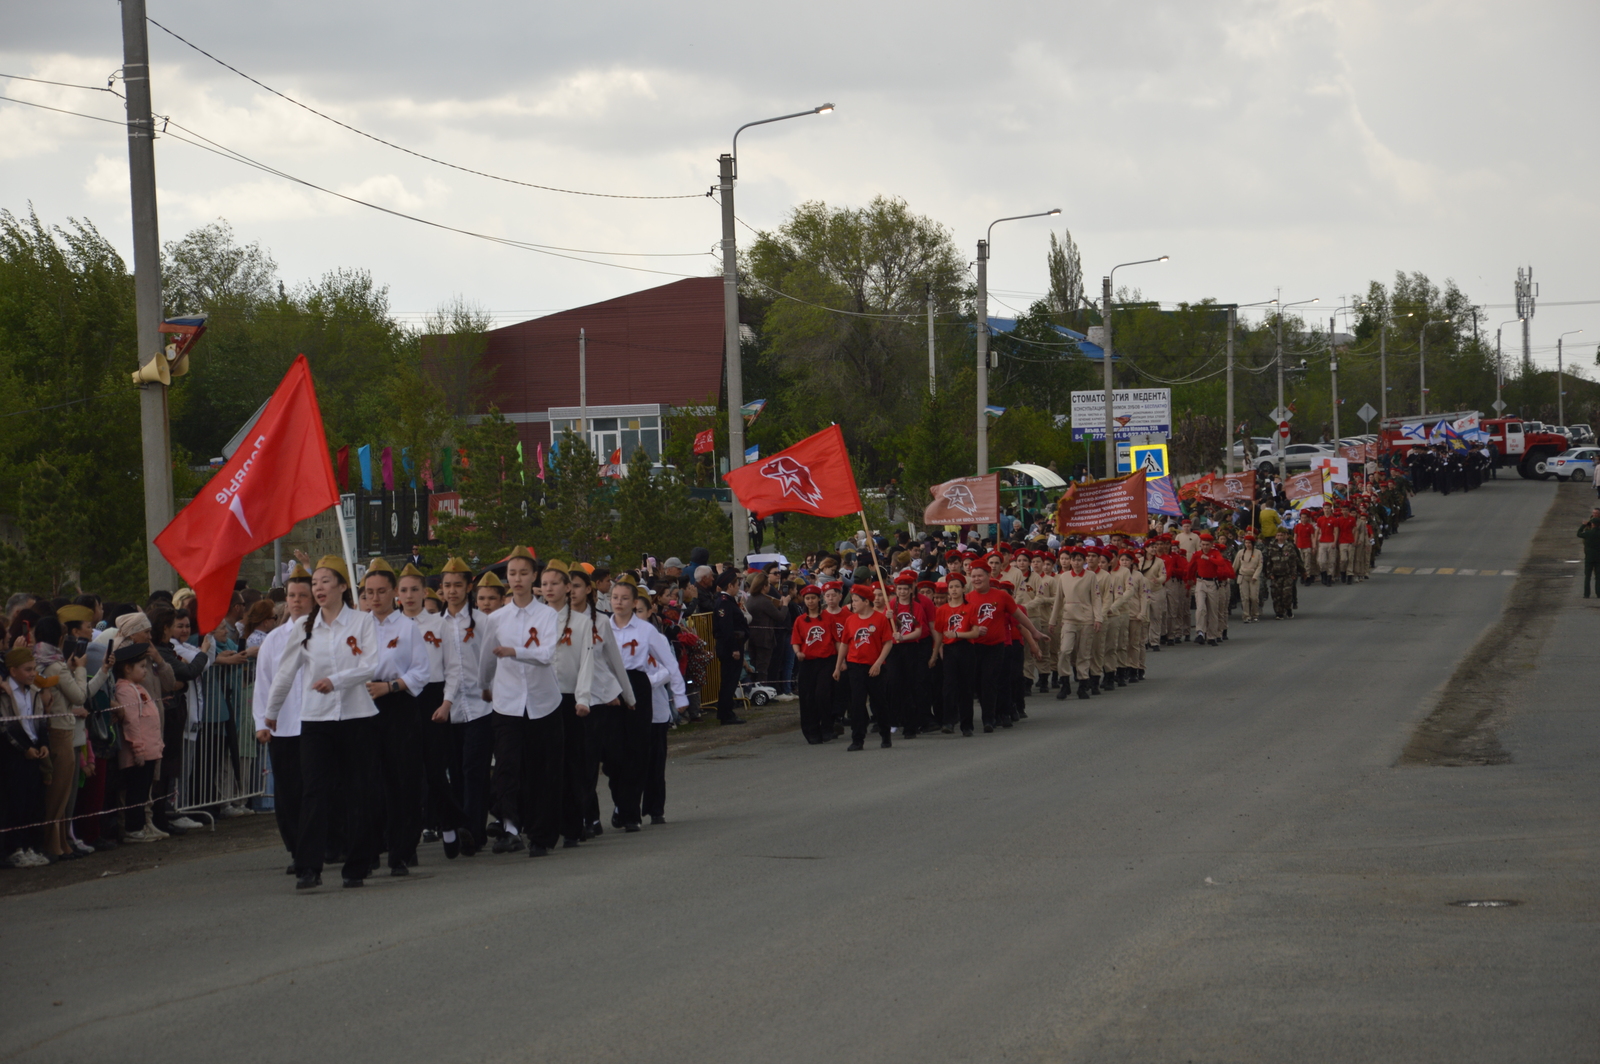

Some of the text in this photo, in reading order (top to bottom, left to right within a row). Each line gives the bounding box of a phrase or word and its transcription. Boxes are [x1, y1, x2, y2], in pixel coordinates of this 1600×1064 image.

[1072, 391, 1167, 403] СТОМАТООГИЯ МЕДЕНТА
[1110, 508, 1131, 516] РАЙОНА
[1098, 514, 1137, 524] БАШКОРТОСТАН
